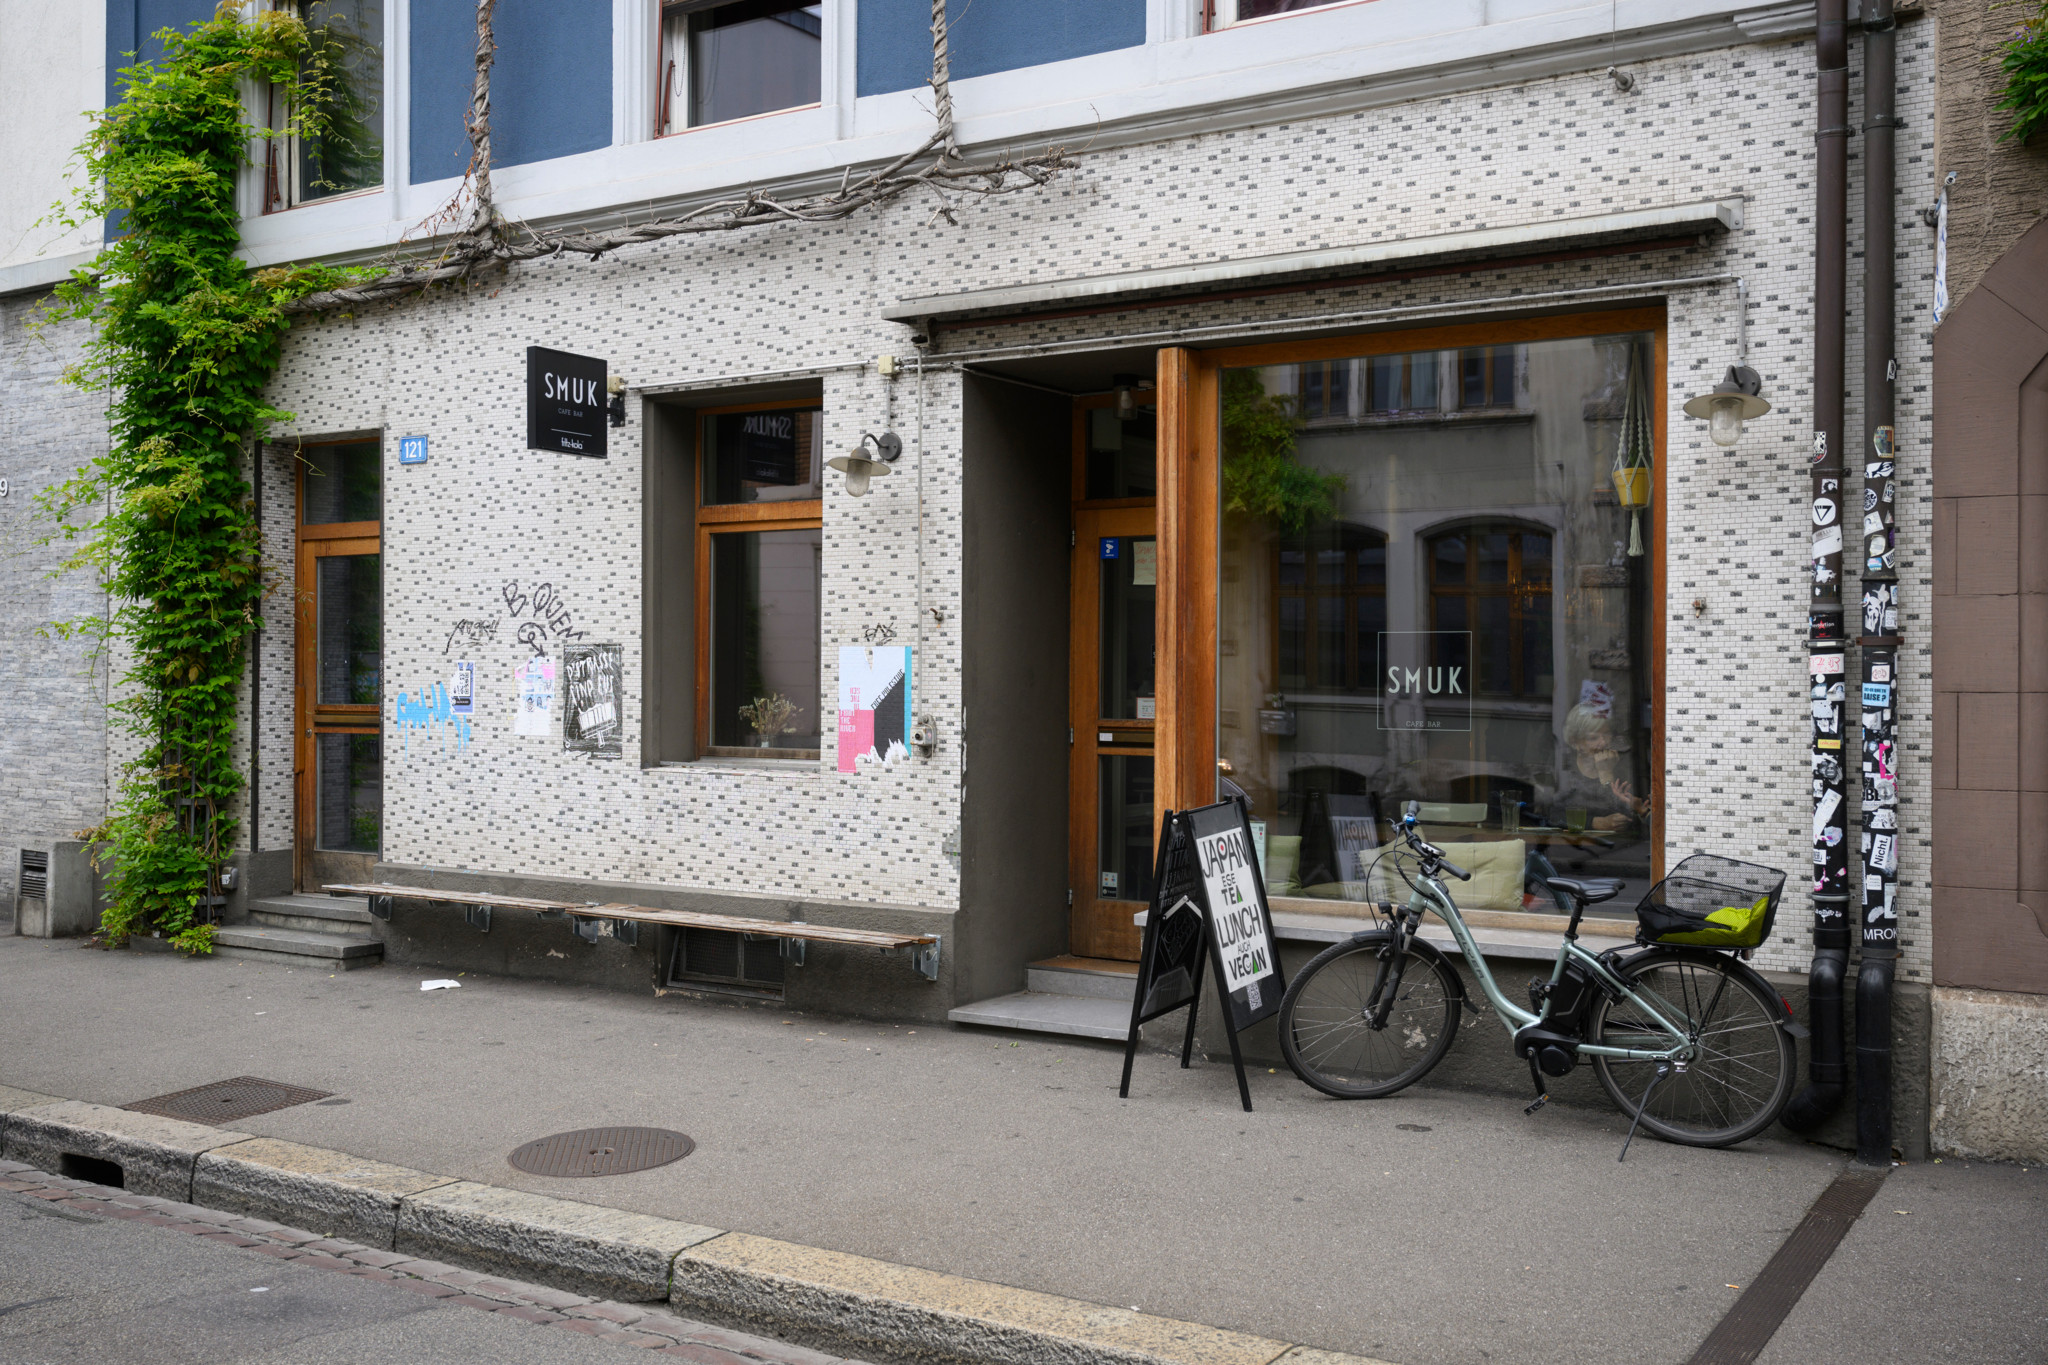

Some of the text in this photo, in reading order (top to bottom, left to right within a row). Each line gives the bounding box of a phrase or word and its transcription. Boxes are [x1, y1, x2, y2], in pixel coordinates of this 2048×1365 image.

[544, 372, 598, 407] SMUK
[557, 407, 583, 418] CAFE BAR
[403, 440, 423, 459] 121
[1387, 665, 1463, 694] SMUK
[840, 717, 851, 725] THE
[1405, 720, 1441, 728] CAFE BAR
[1201, 830, 1250, 879] JAPAN
[1873, 837, 1889, 866] Nicht.
[1221, 873, 1237, 888] ESE
[1221, 885, 1243, 906] TEA
[1215, 903, 1262, 949] LUNCH
[1237, 940, 1252, 953] AUCH
[1456, 932, 1485, 979] FLYER
[1228, 950, 1268, 982] VEGAN
